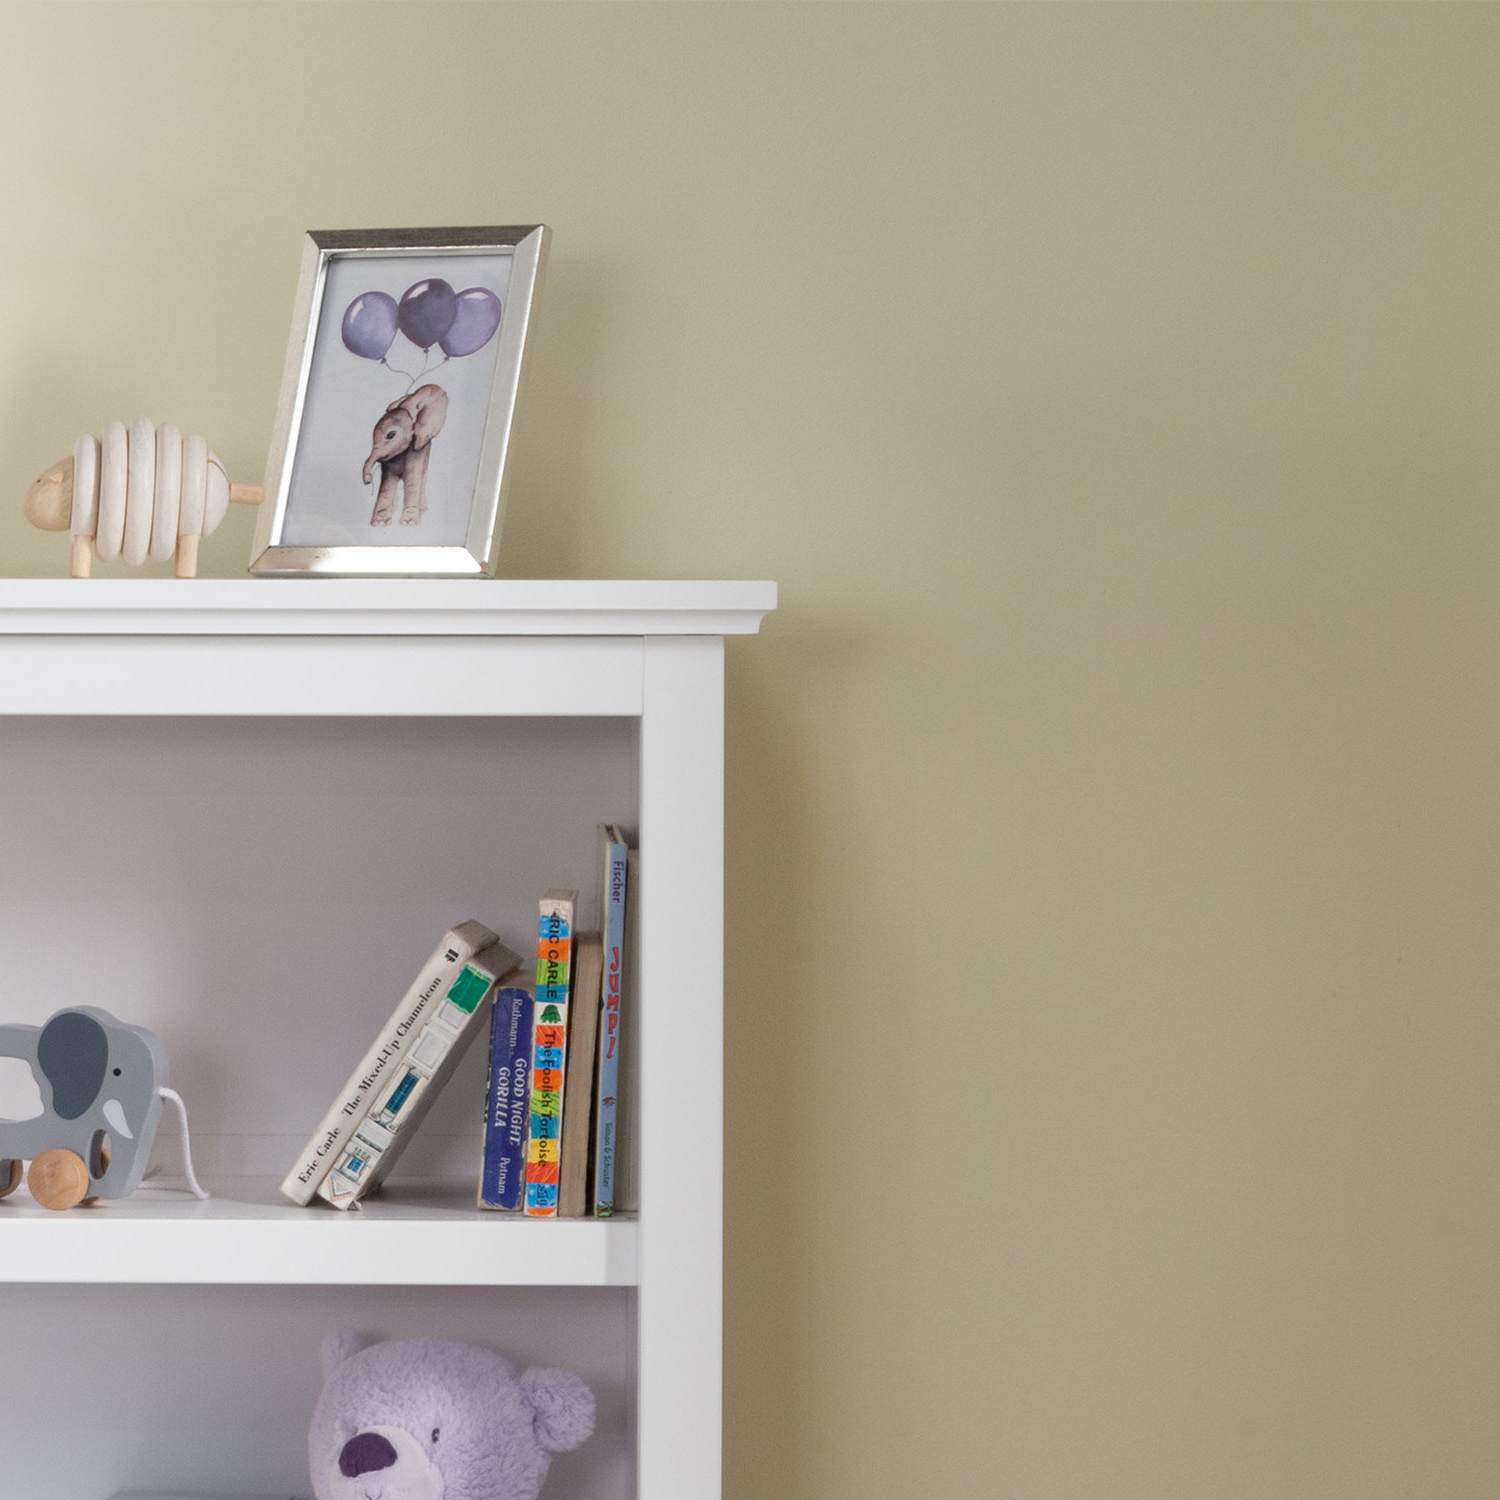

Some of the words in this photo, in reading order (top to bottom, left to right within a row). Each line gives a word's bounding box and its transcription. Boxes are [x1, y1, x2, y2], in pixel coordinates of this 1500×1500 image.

[612, 861, 625, 903] Fischer
[546, 949, 559, 999] CARLE
[509, 998, 523, 1047] Rathmann
[606, 946, 620, 1059] JUMP!
[341, 1093, 362, 1116] The
[358, 1040, 400, 1093] Mixed-Up
[396, 977, 442, 1037] Chameleon
[544, 1031, 557, 1057] The
[495, 1066, 511, 1127] GORILLA
[513, 1057, 527, 1097] GOOD
[541, 1060, 556, 1107] Foolish
[298, 1159, 319, 1184] Eric
[316, 1127, 340, 1157] Carle
[538, 1110, 553, 1167] Tortoise
[604, 1122, 613, 1146] Simon
[498, 1157, 511, 1194] Putnam
[602, 1155, 612, 1188] Schuster
